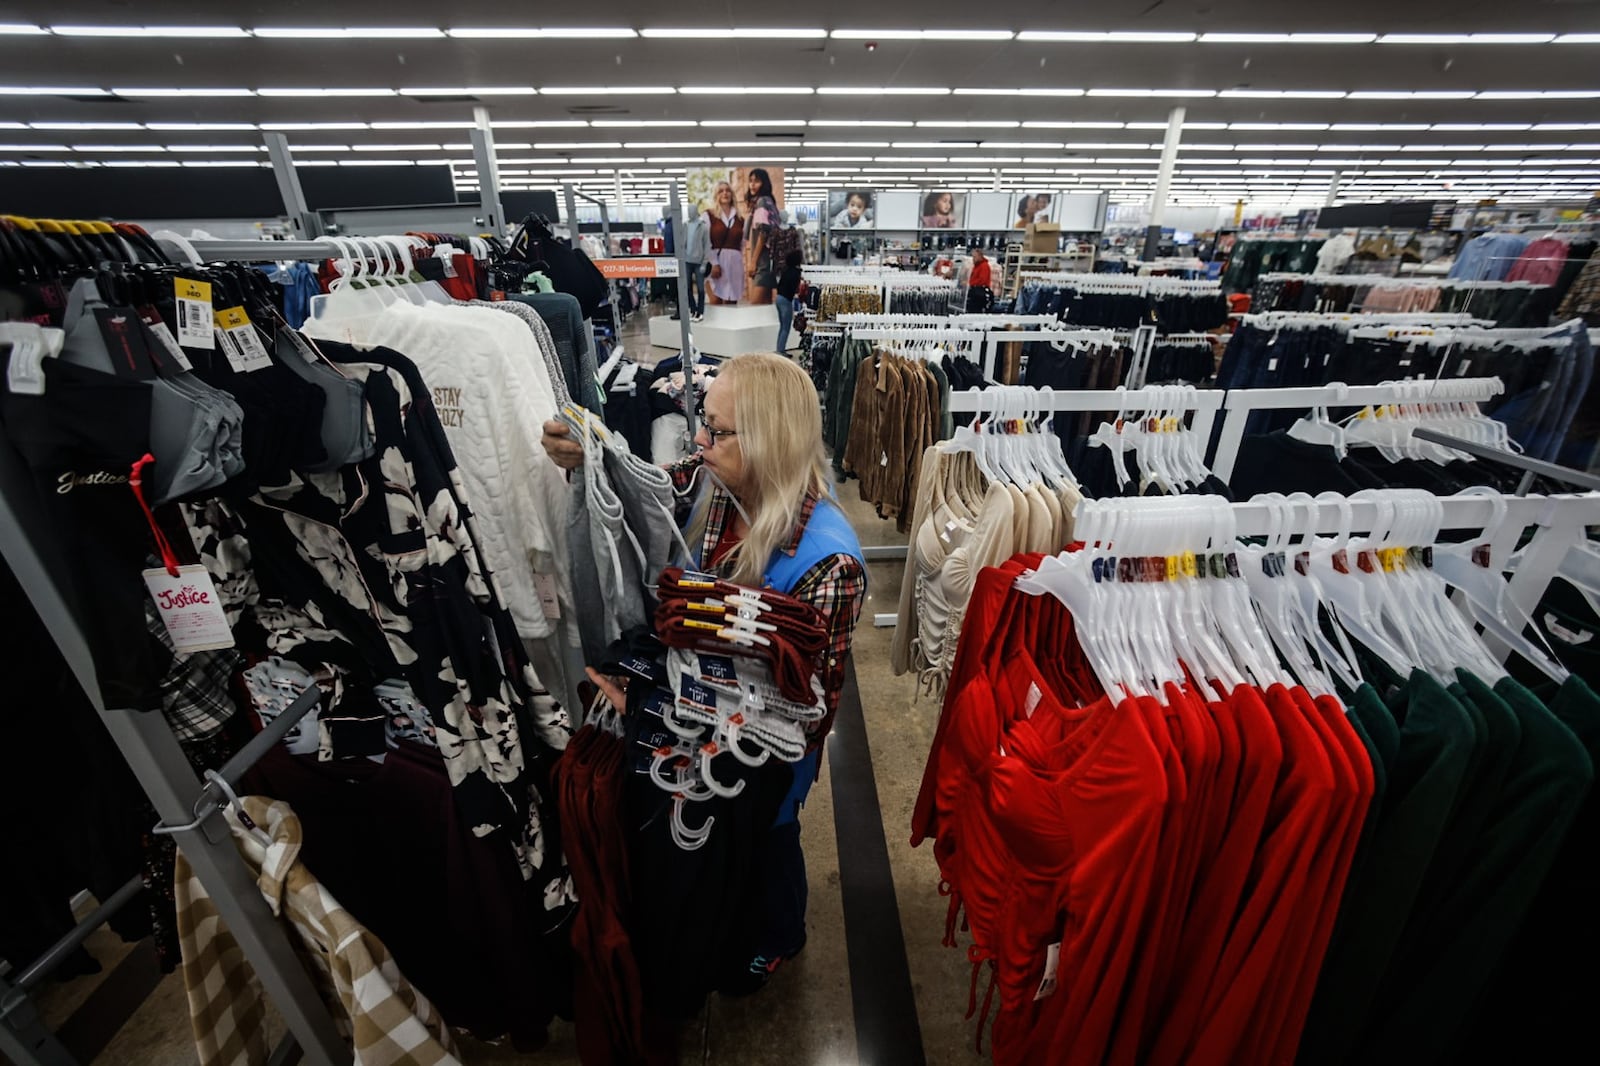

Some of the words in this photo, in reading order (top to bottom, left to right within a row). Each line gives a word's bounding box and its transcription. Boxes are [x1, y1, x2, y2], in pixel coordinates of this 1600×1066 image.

[625, 264, 654, 272] Intimates
[434, 387, 461, 407] STAY
[57, 471, 129, 494] Justice
[158, 588, 210, 610] Justice
